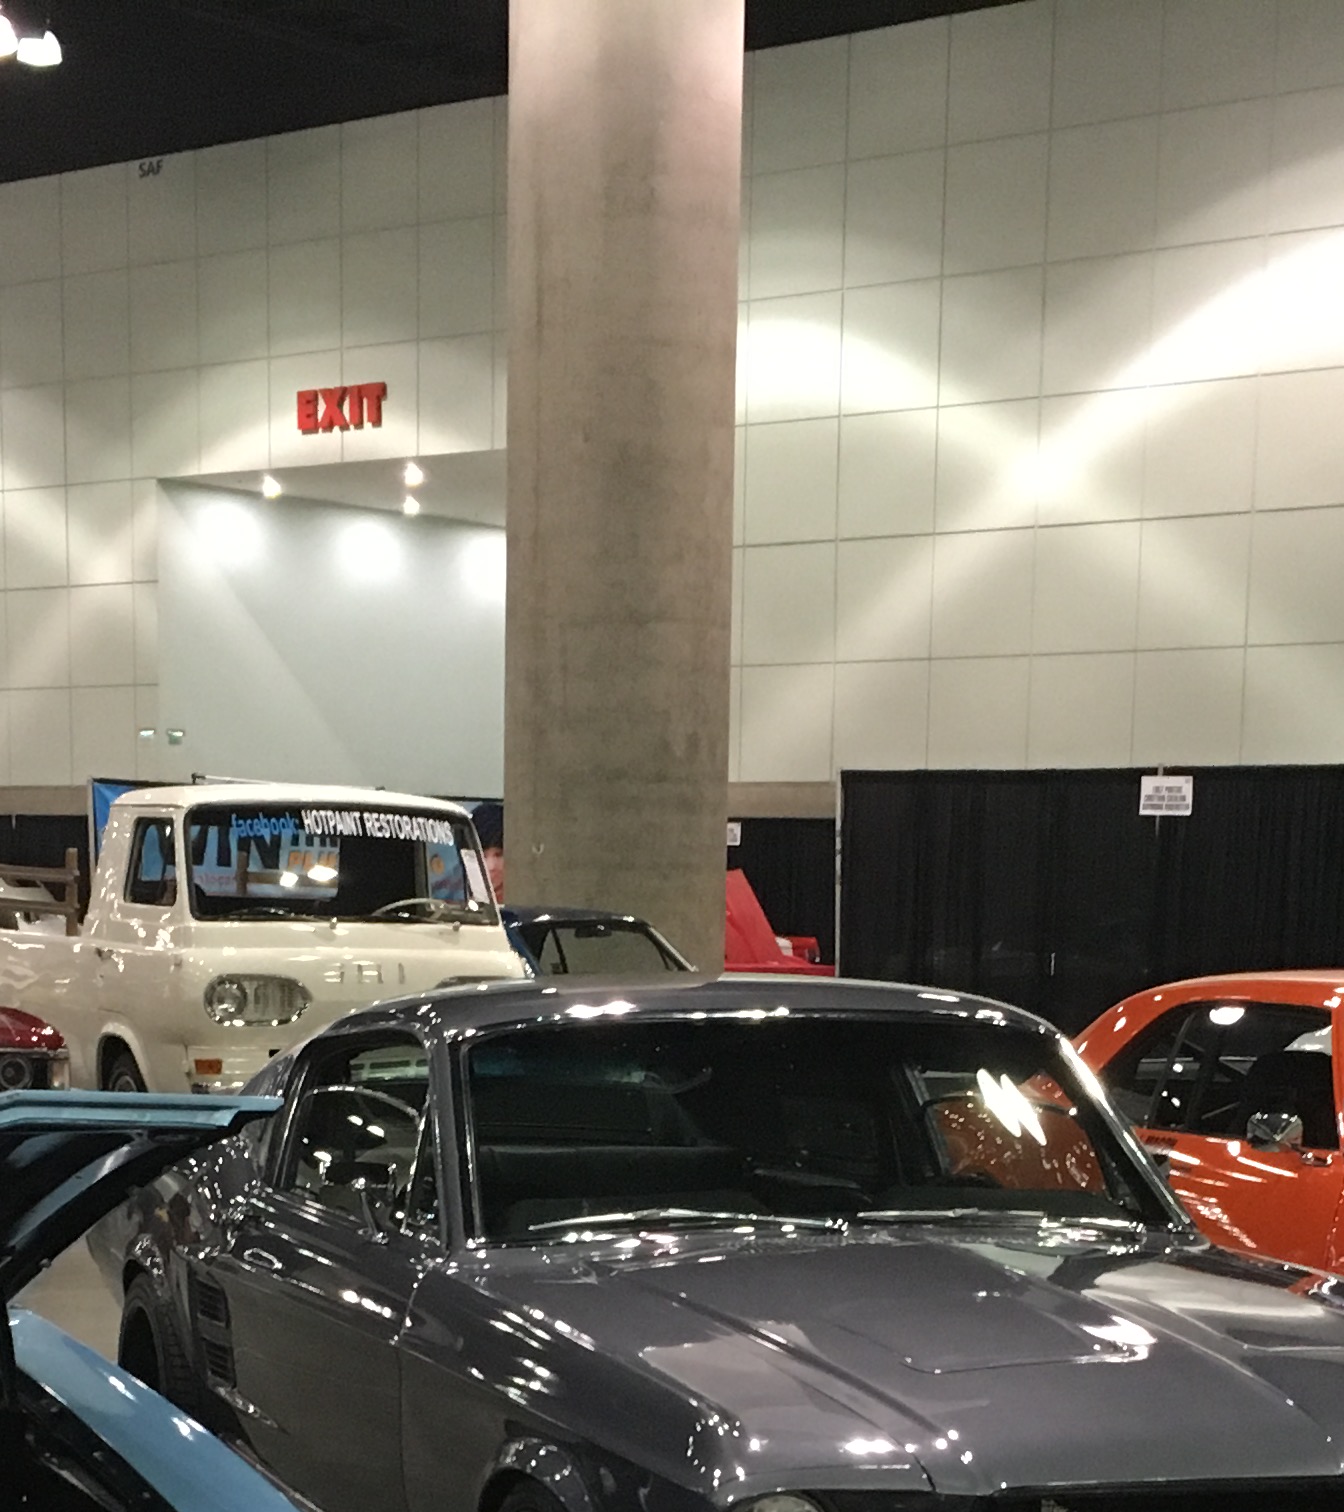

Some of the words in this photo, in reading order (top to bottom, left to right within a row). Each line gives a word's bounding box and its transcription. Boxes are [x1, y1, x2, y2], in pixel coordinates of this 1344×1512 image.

[297, 382, 387, 434] EXIT
[301, 809, 363, 837] HOTPAINT
[363, 812, 454, 847] RESTORATIONS
